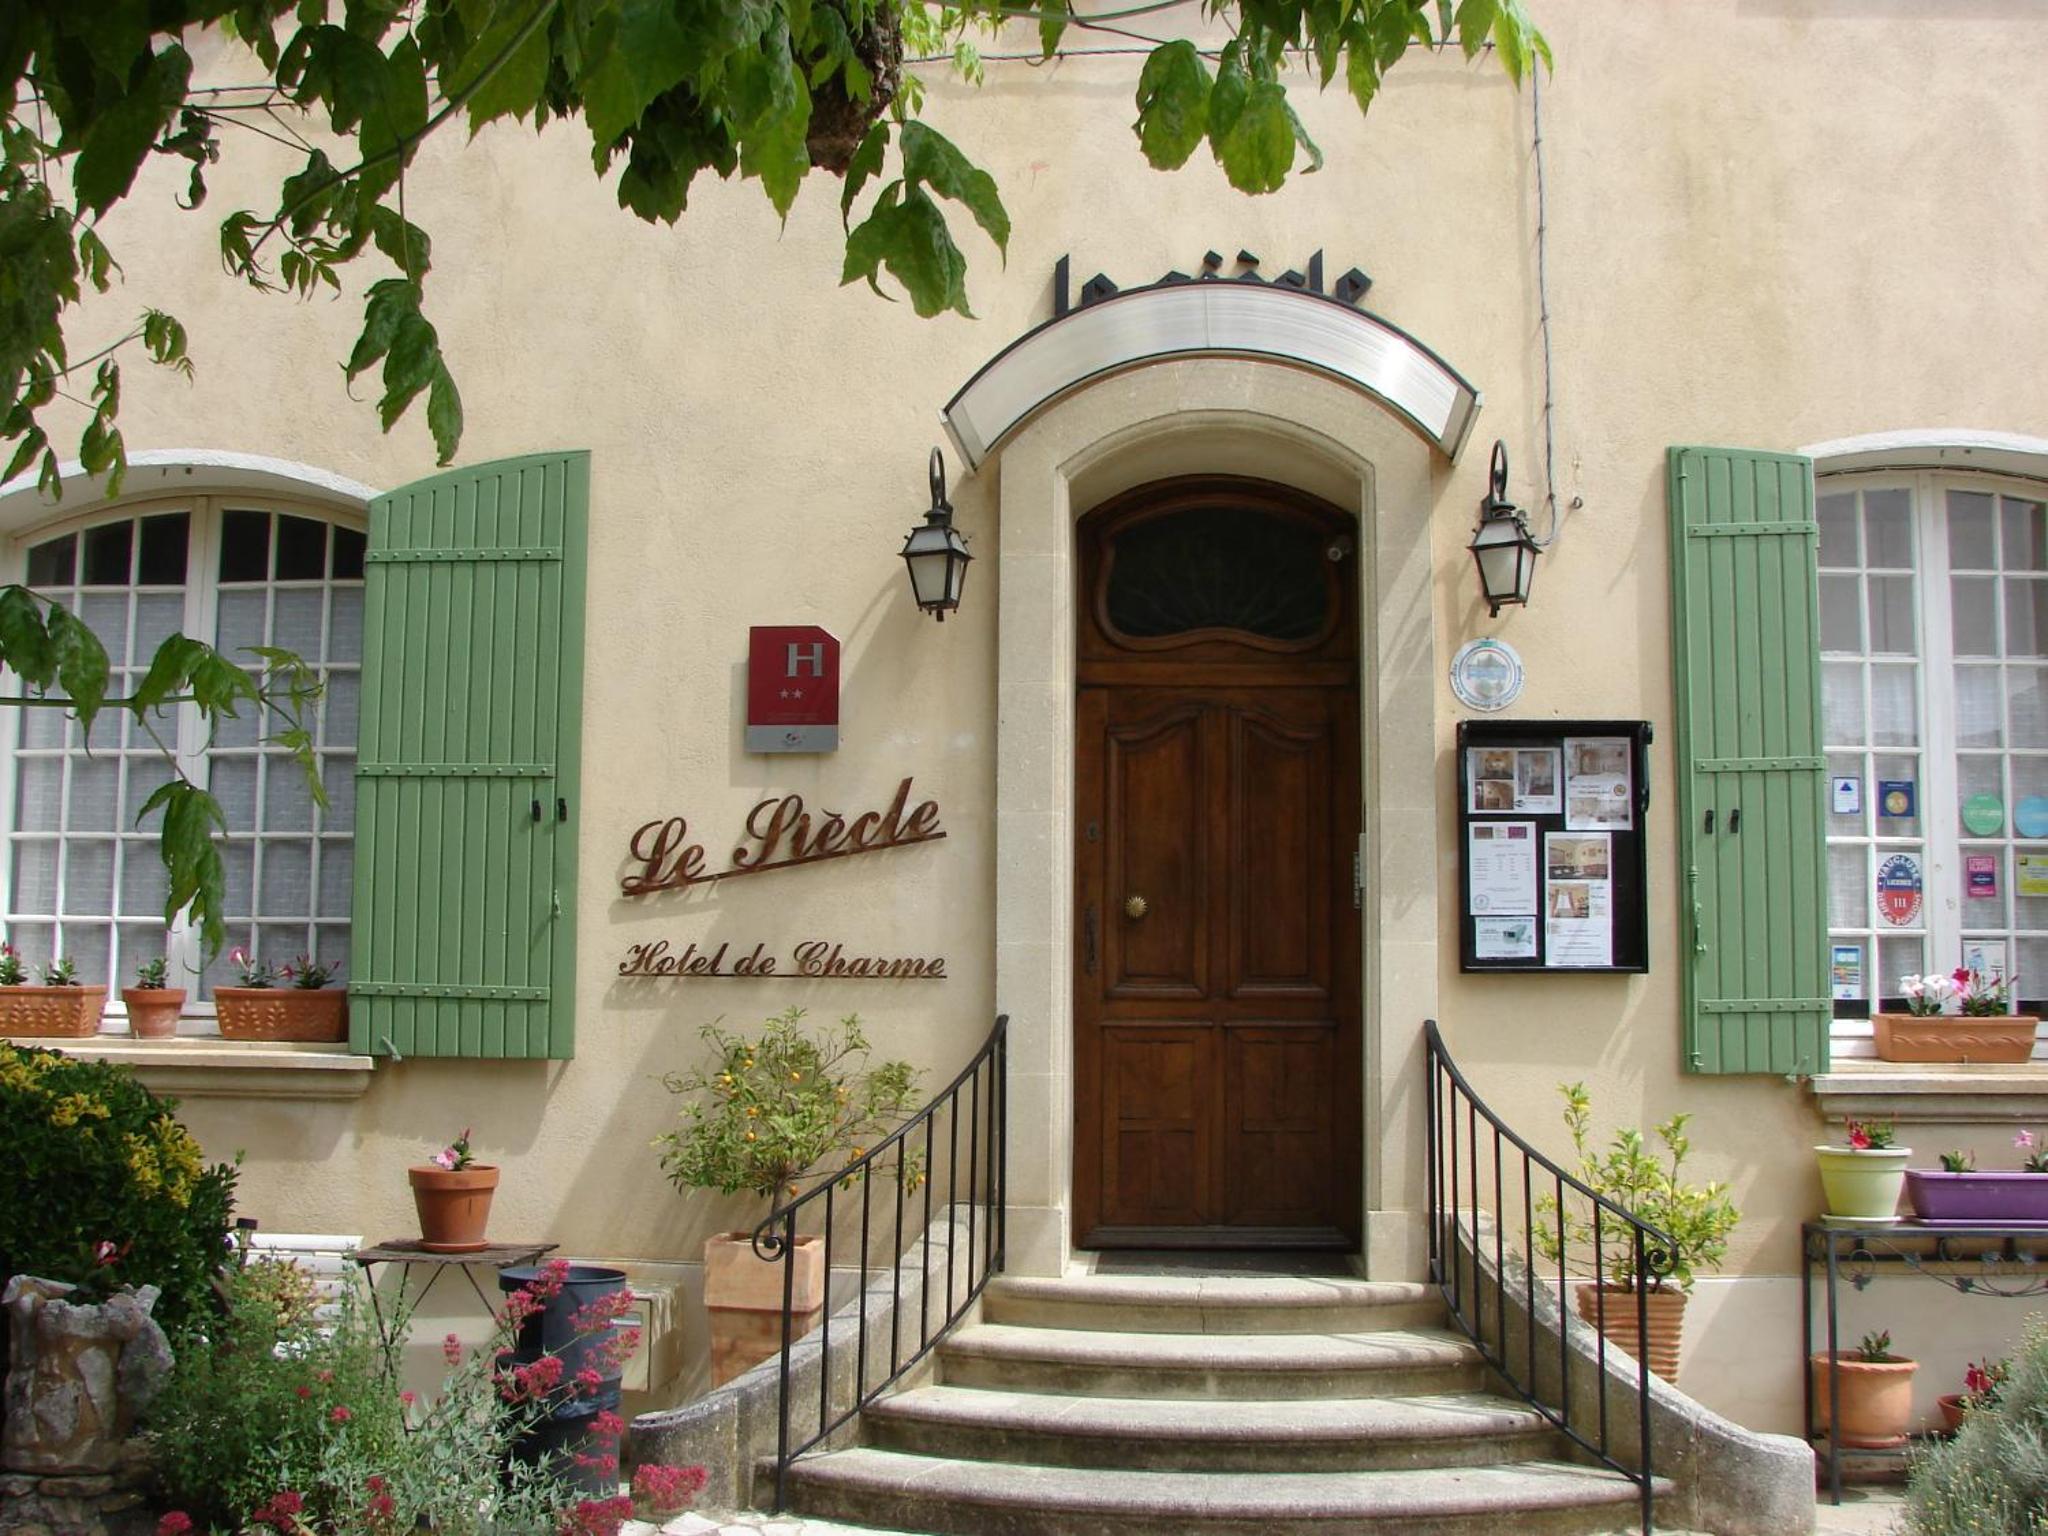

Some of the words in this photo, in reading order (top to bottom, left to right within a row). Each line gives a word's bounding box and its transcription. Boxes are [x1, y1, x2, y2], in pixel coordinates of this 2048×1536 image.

[786, 643, 823, 677] H
[621, 817, 706, 890] Le
[733, 777, 940, 868] Siècle
[619, 940, 729, 974] Hotel
[734, 943, 776, 974] de
[794, 941, 946, 976] Charme
